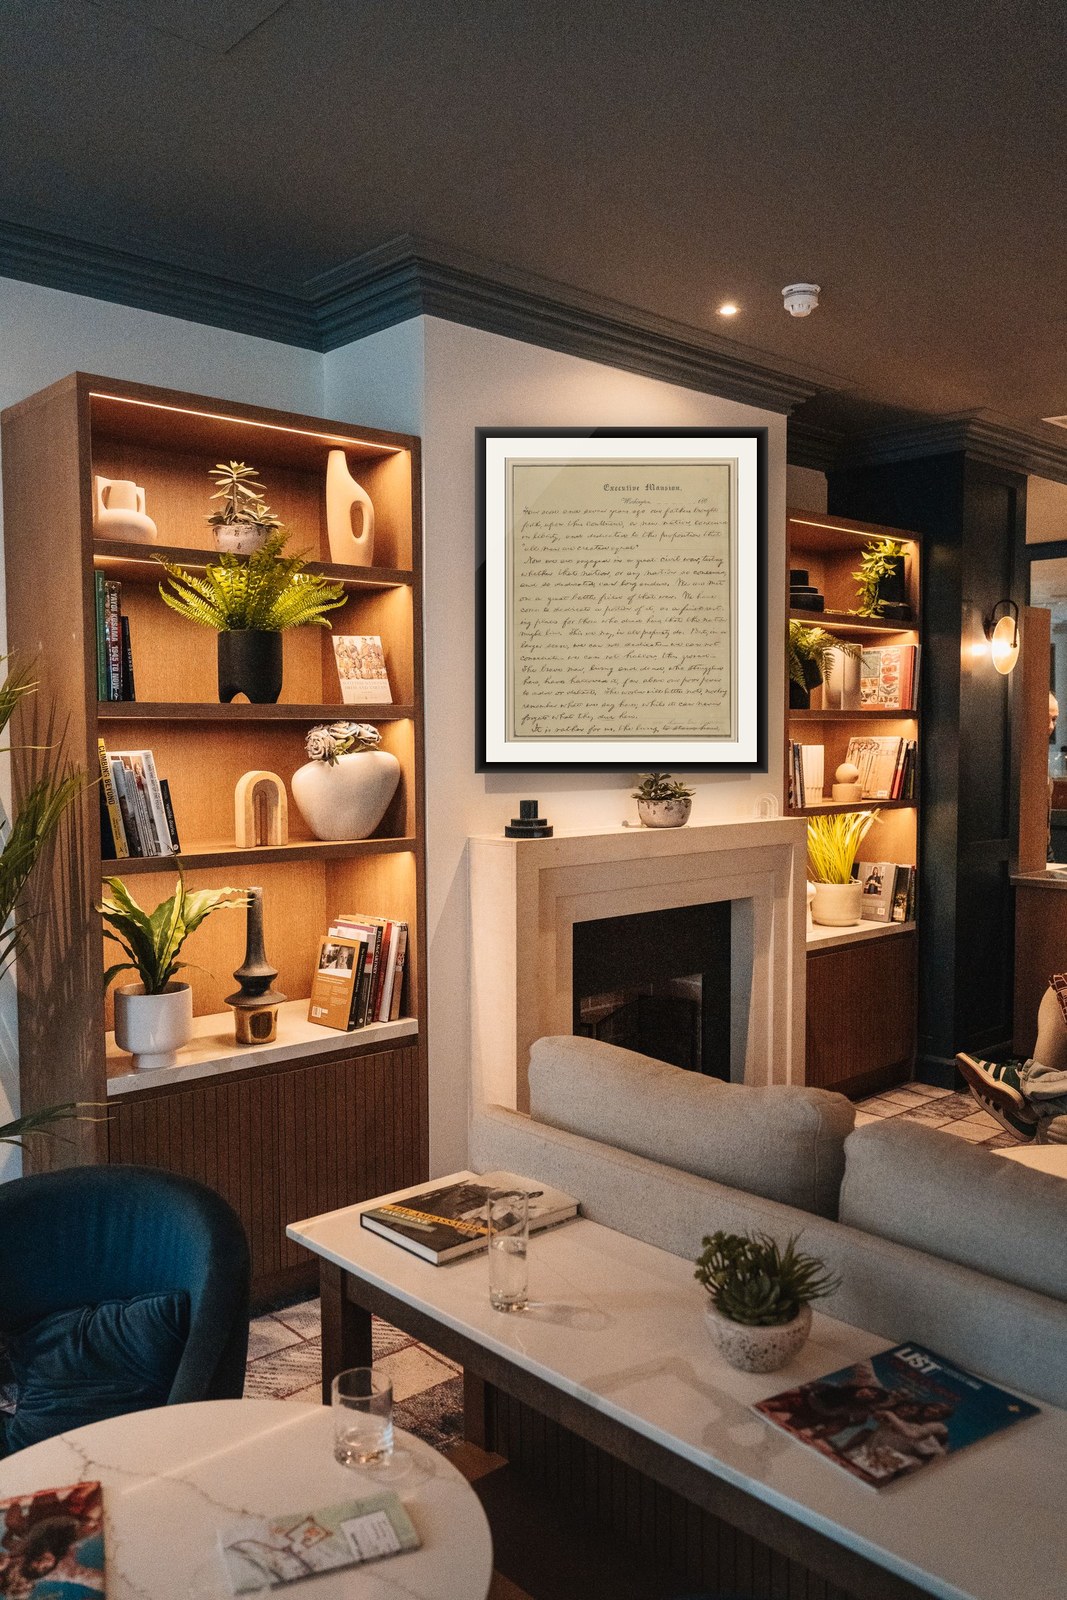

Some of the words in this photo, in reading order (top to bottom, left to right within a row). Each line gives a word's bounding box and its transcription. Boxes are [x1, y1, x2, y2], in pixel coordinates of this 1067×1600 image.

[603, 483, 640, 492] Executive
[111, 613, 119, 642] KUSAMA
[111, 646, 119, 662] 1945
[112, 664, 119, 672] TO
[98, 745, 110, 778] CLIMBING
[104, 779, 116, 805] BEYOND
[380, 1208, 432, 1225] MAGAZINE
[895, 1347, 942, 1375] LIST
